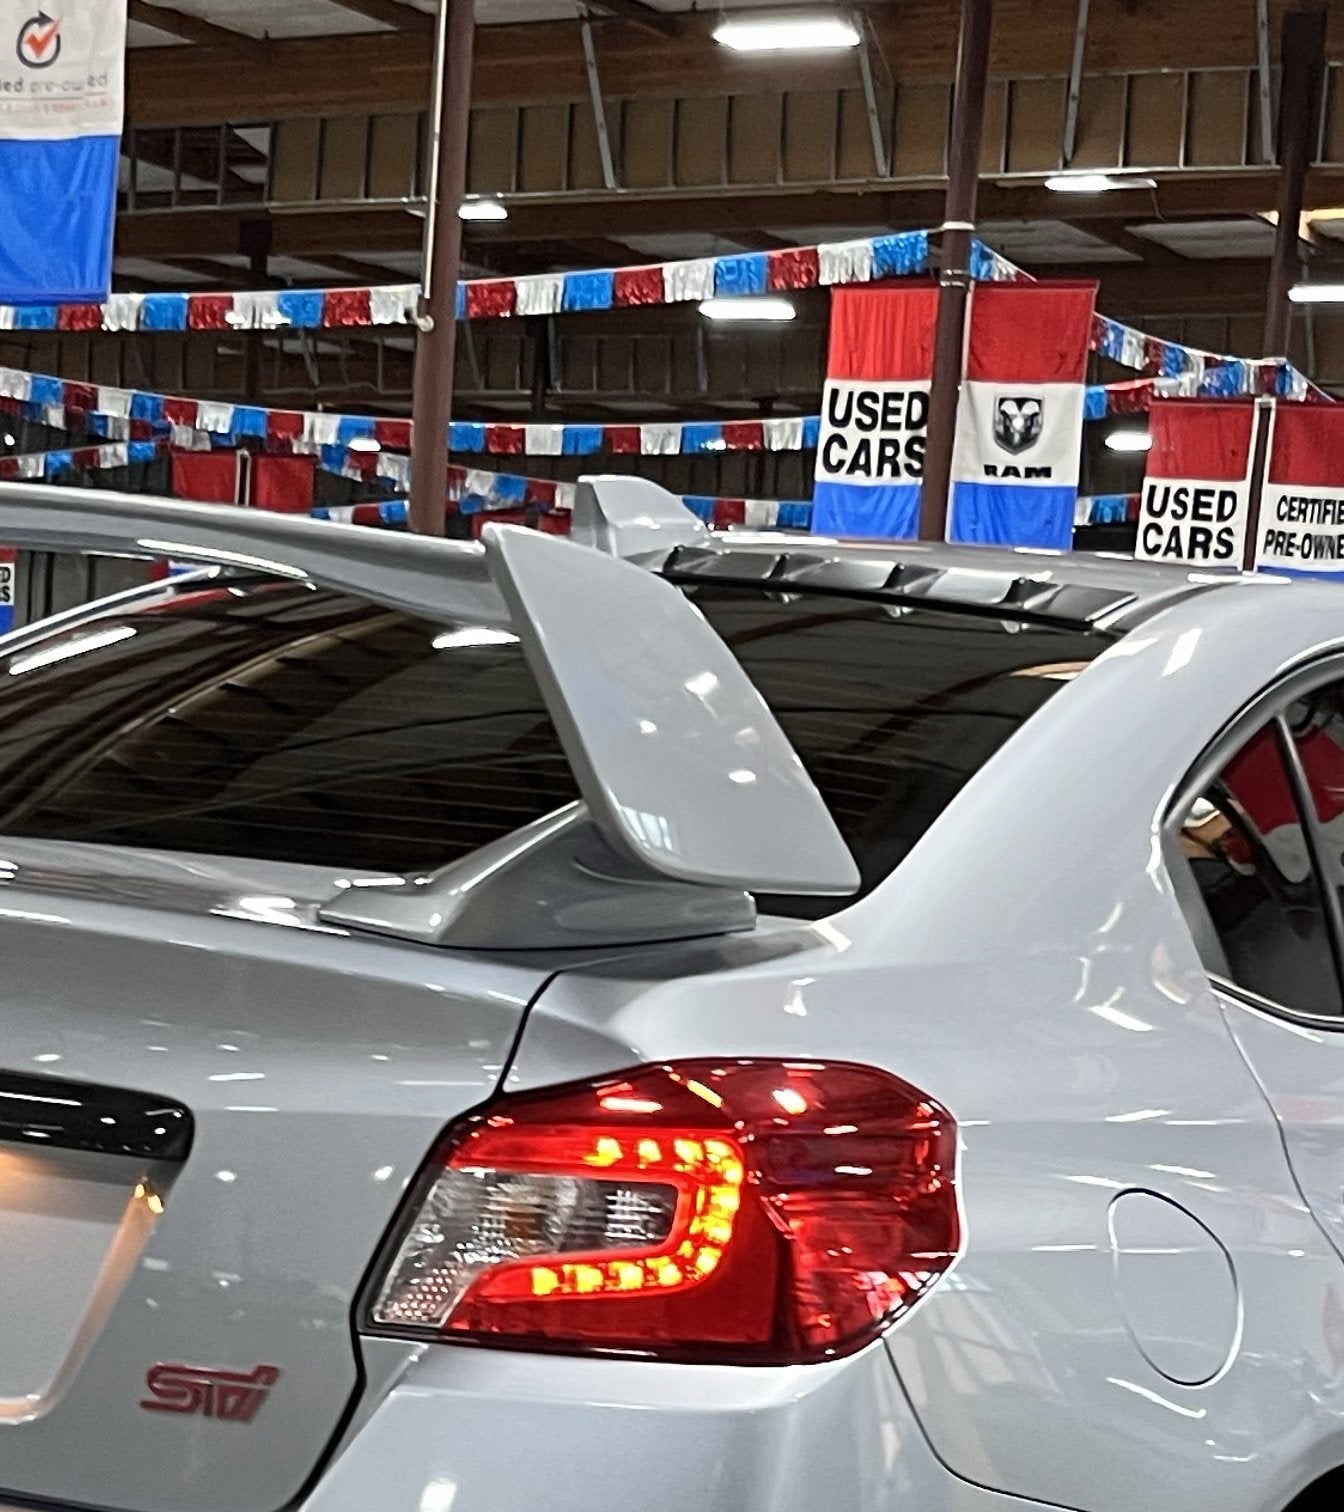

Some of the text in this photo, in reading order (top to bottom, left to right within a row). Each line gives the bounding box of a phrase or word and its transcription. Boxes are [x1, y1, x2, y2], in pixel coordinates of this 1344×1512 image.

[828, 388, 929, 431] USED
[823, 433, 927, 477] CARS
[983, 464, 1052, 479] RAM
[1146, 485, 1238, 522] USED
[1143, 522, 1234, 559] CARS
